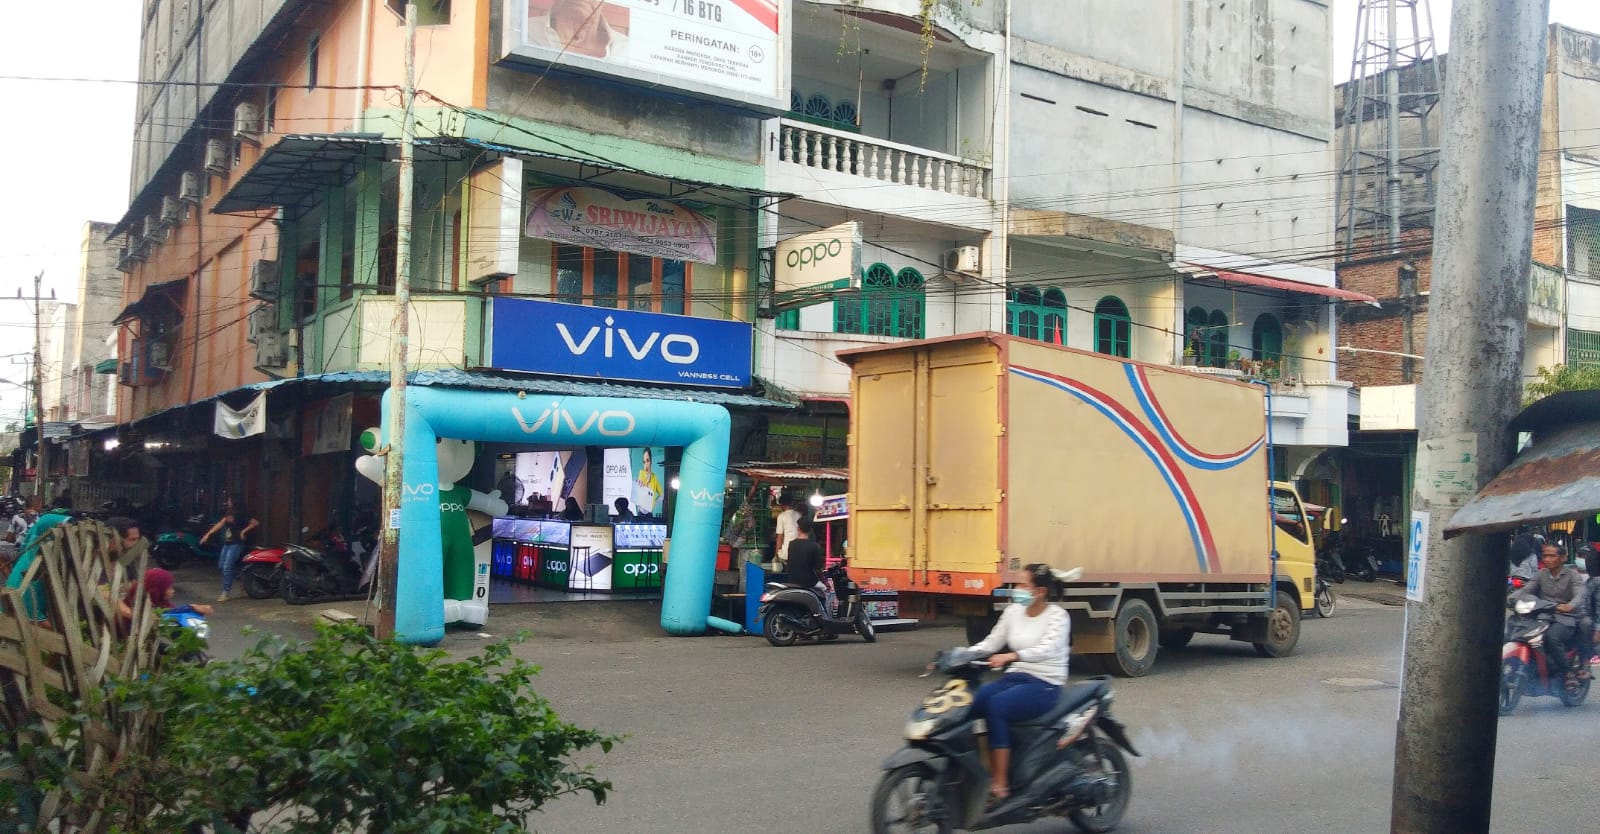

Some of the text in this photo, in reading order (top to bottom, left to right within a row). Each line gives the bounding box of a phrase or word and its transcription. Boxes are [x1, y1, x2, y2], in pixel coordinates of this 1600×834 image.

[698, 0, 722, 23] BTG
[670, 29, 740, 53] PERINGATAN:
[751, 50, 762, 58] 18+
[585, 204, 694, 237] SRIWIJAYA
[786, 238, 842, 271] oppo
[556, 315, 700, 365] vivo
[678, 370, 741, 382] VANNESS CELL
[511, 400, 636, 437] vivo
[401, 481, 434, 496] ivo
[439, 502, 464, 513] ppo
[624, 563, 659, 577] opp
